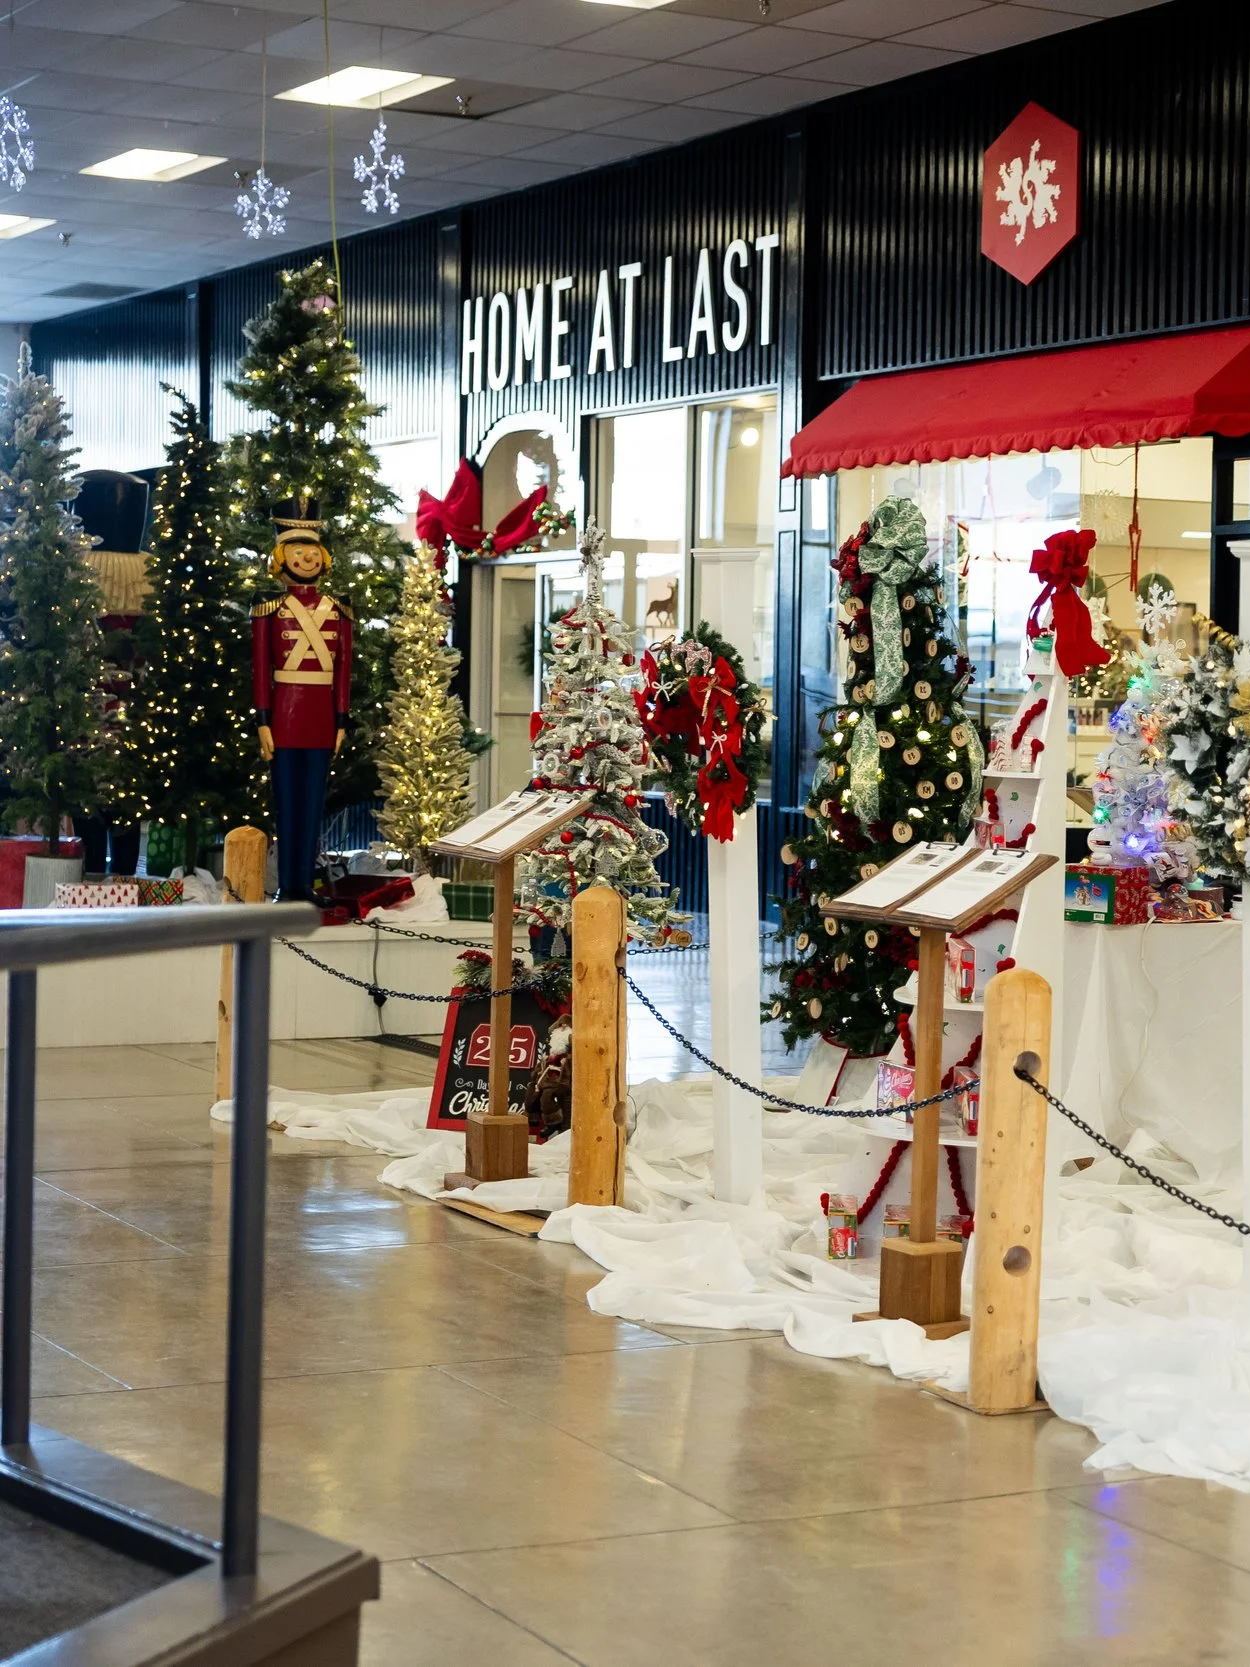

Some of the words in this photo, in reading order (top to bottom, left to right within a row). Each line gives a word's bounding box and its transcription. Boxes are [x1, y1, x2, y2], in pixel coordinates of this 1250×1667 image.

[460, 276, 574, 395] HOME
[588, 261, 642, 376] AT
[662, 233, 780, 363] LAST
[473, 1036, 529, 1063] 25
